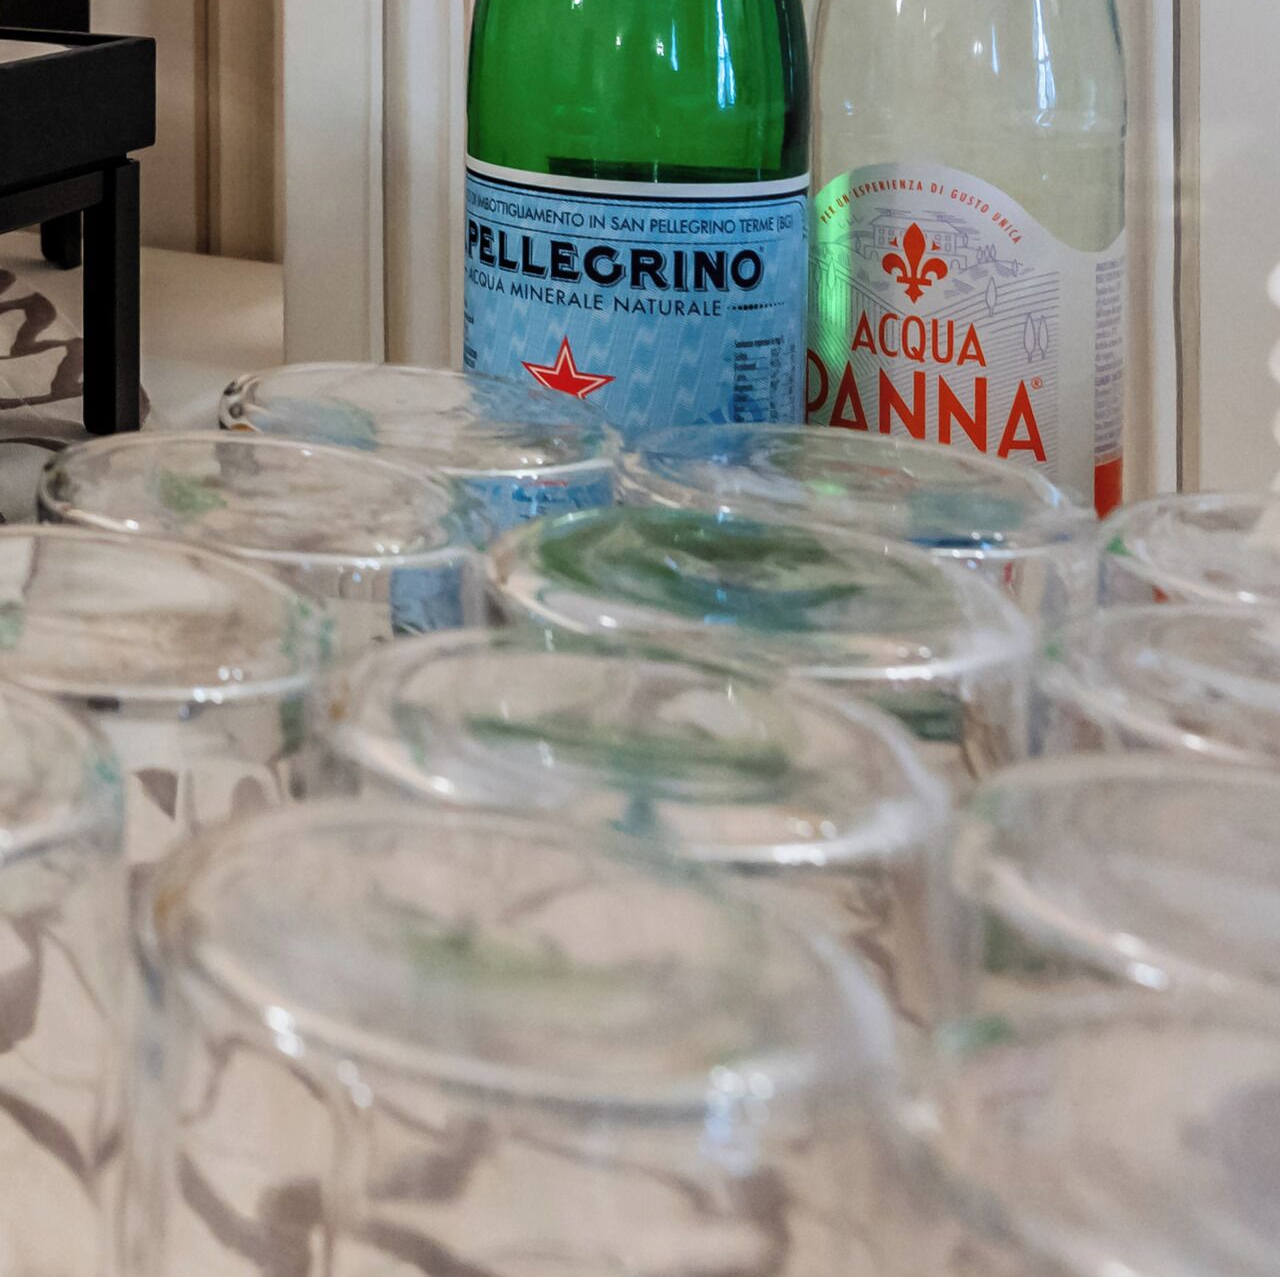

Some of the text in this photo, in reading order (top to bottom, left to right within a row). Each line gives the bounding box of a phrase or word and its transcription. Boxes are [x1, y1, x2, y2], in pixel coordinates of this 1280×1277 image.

[477, 195, 585, 228] IMBOTTIGLIAMENTO
[589, 215, 606, 230] IN
[611, 216, 645, 233] SAN
[649, 218, 737, 235] PELLEGRINO
[741, 216, 775, 233] TERME
[820, 207, 837, 225] PER
[930, 181, 945, 195] DI
[950, 188, 991, 215] GUSTO
[991, 211, 1024, 245] UNICA
[469, 269, 722, 317] ACQUA MINERALE NATURALE
[850, 308, 987, 368] ACQUA
[806, 347, 1048, 463] PANNA
